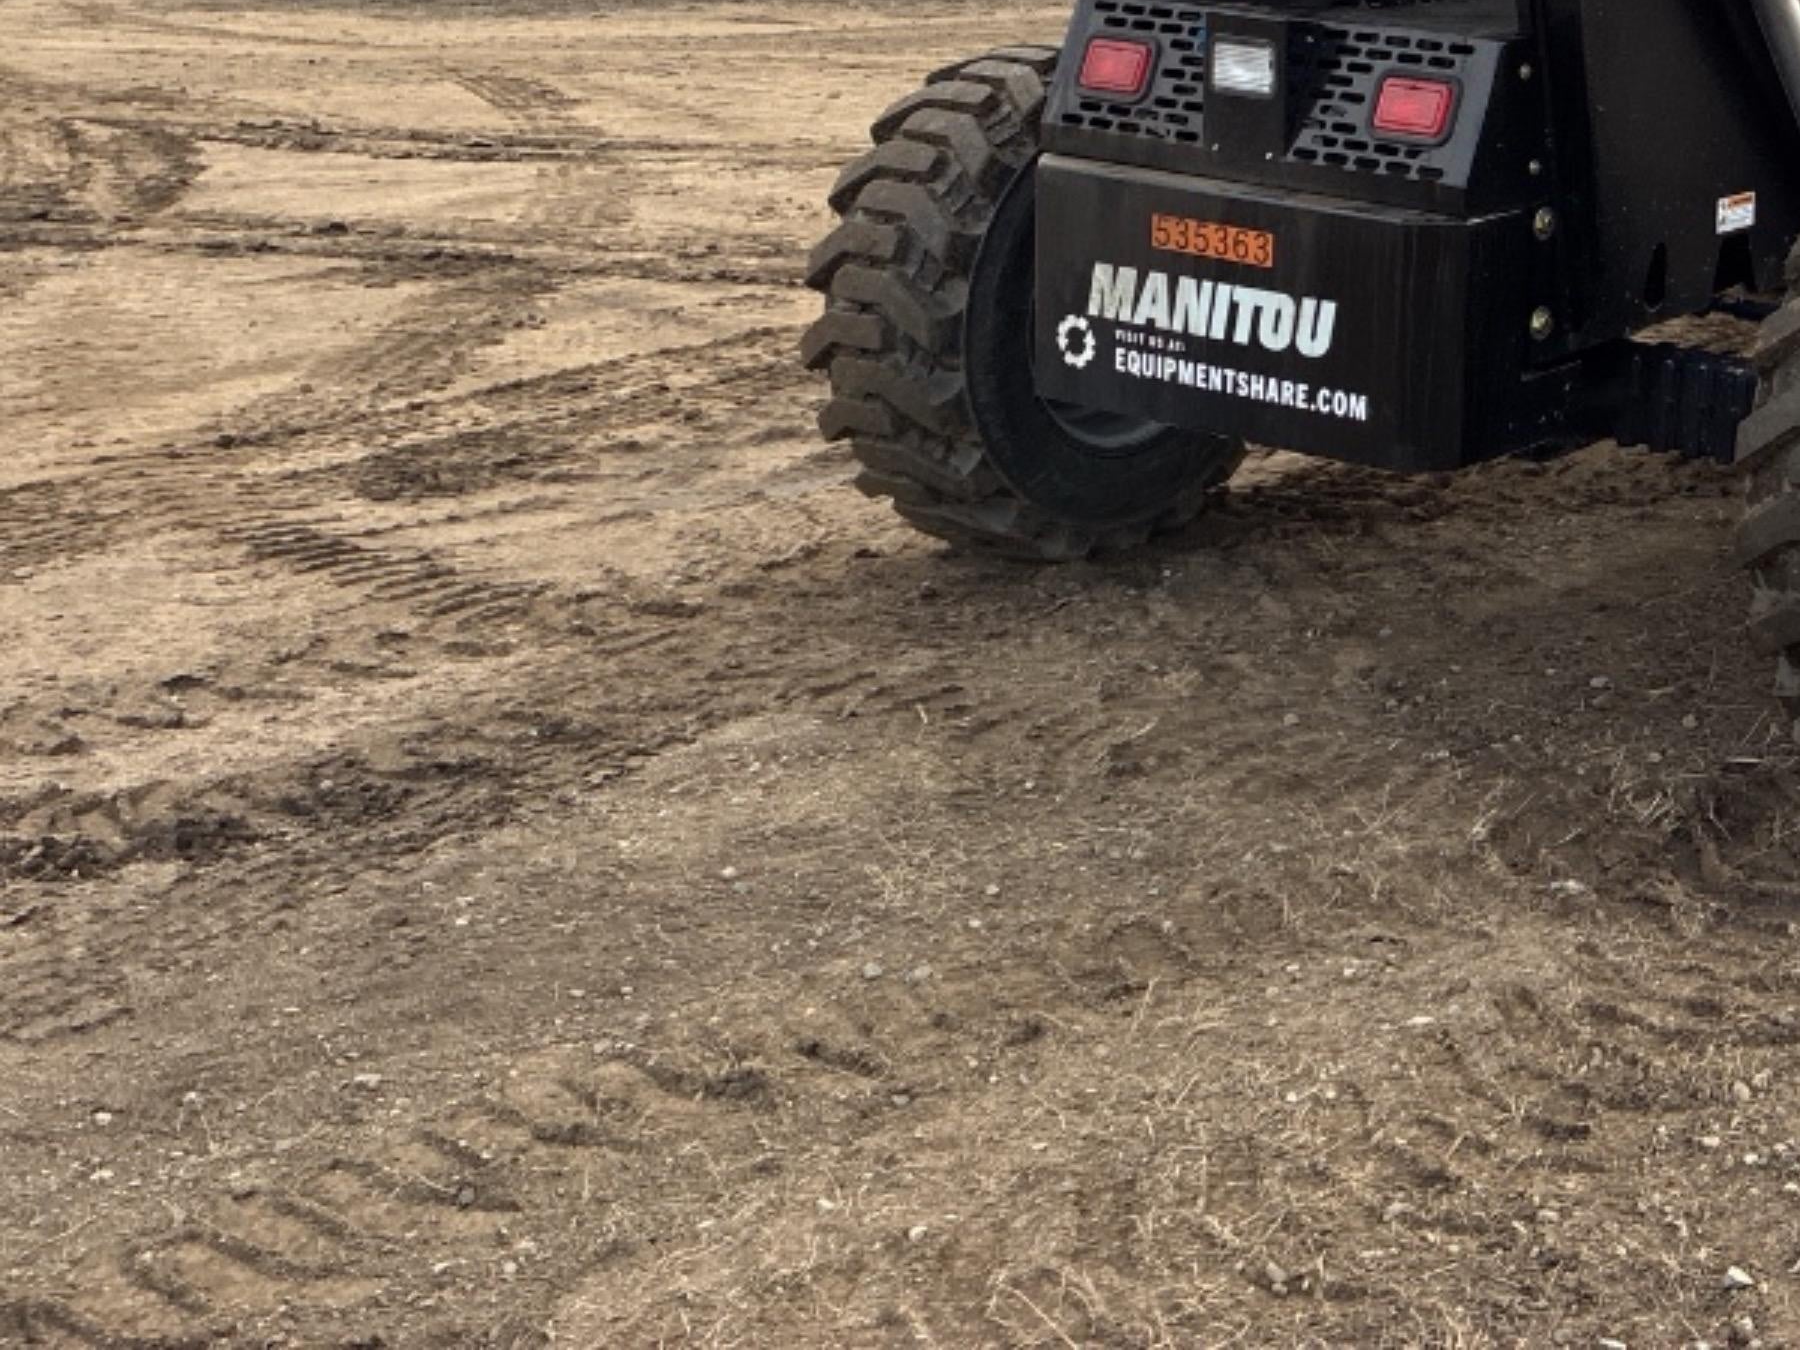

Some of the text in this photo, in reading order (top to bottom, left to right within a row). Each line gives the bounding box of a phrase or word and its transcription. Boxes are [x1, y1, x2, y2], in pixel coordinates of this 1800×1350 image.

[1153, 215, 1270, 265] 535363
[1088, 262, 1338, 359] MANITOU
[1114, 347, 1369, 421] EQUIPMENTSHARE.COM
